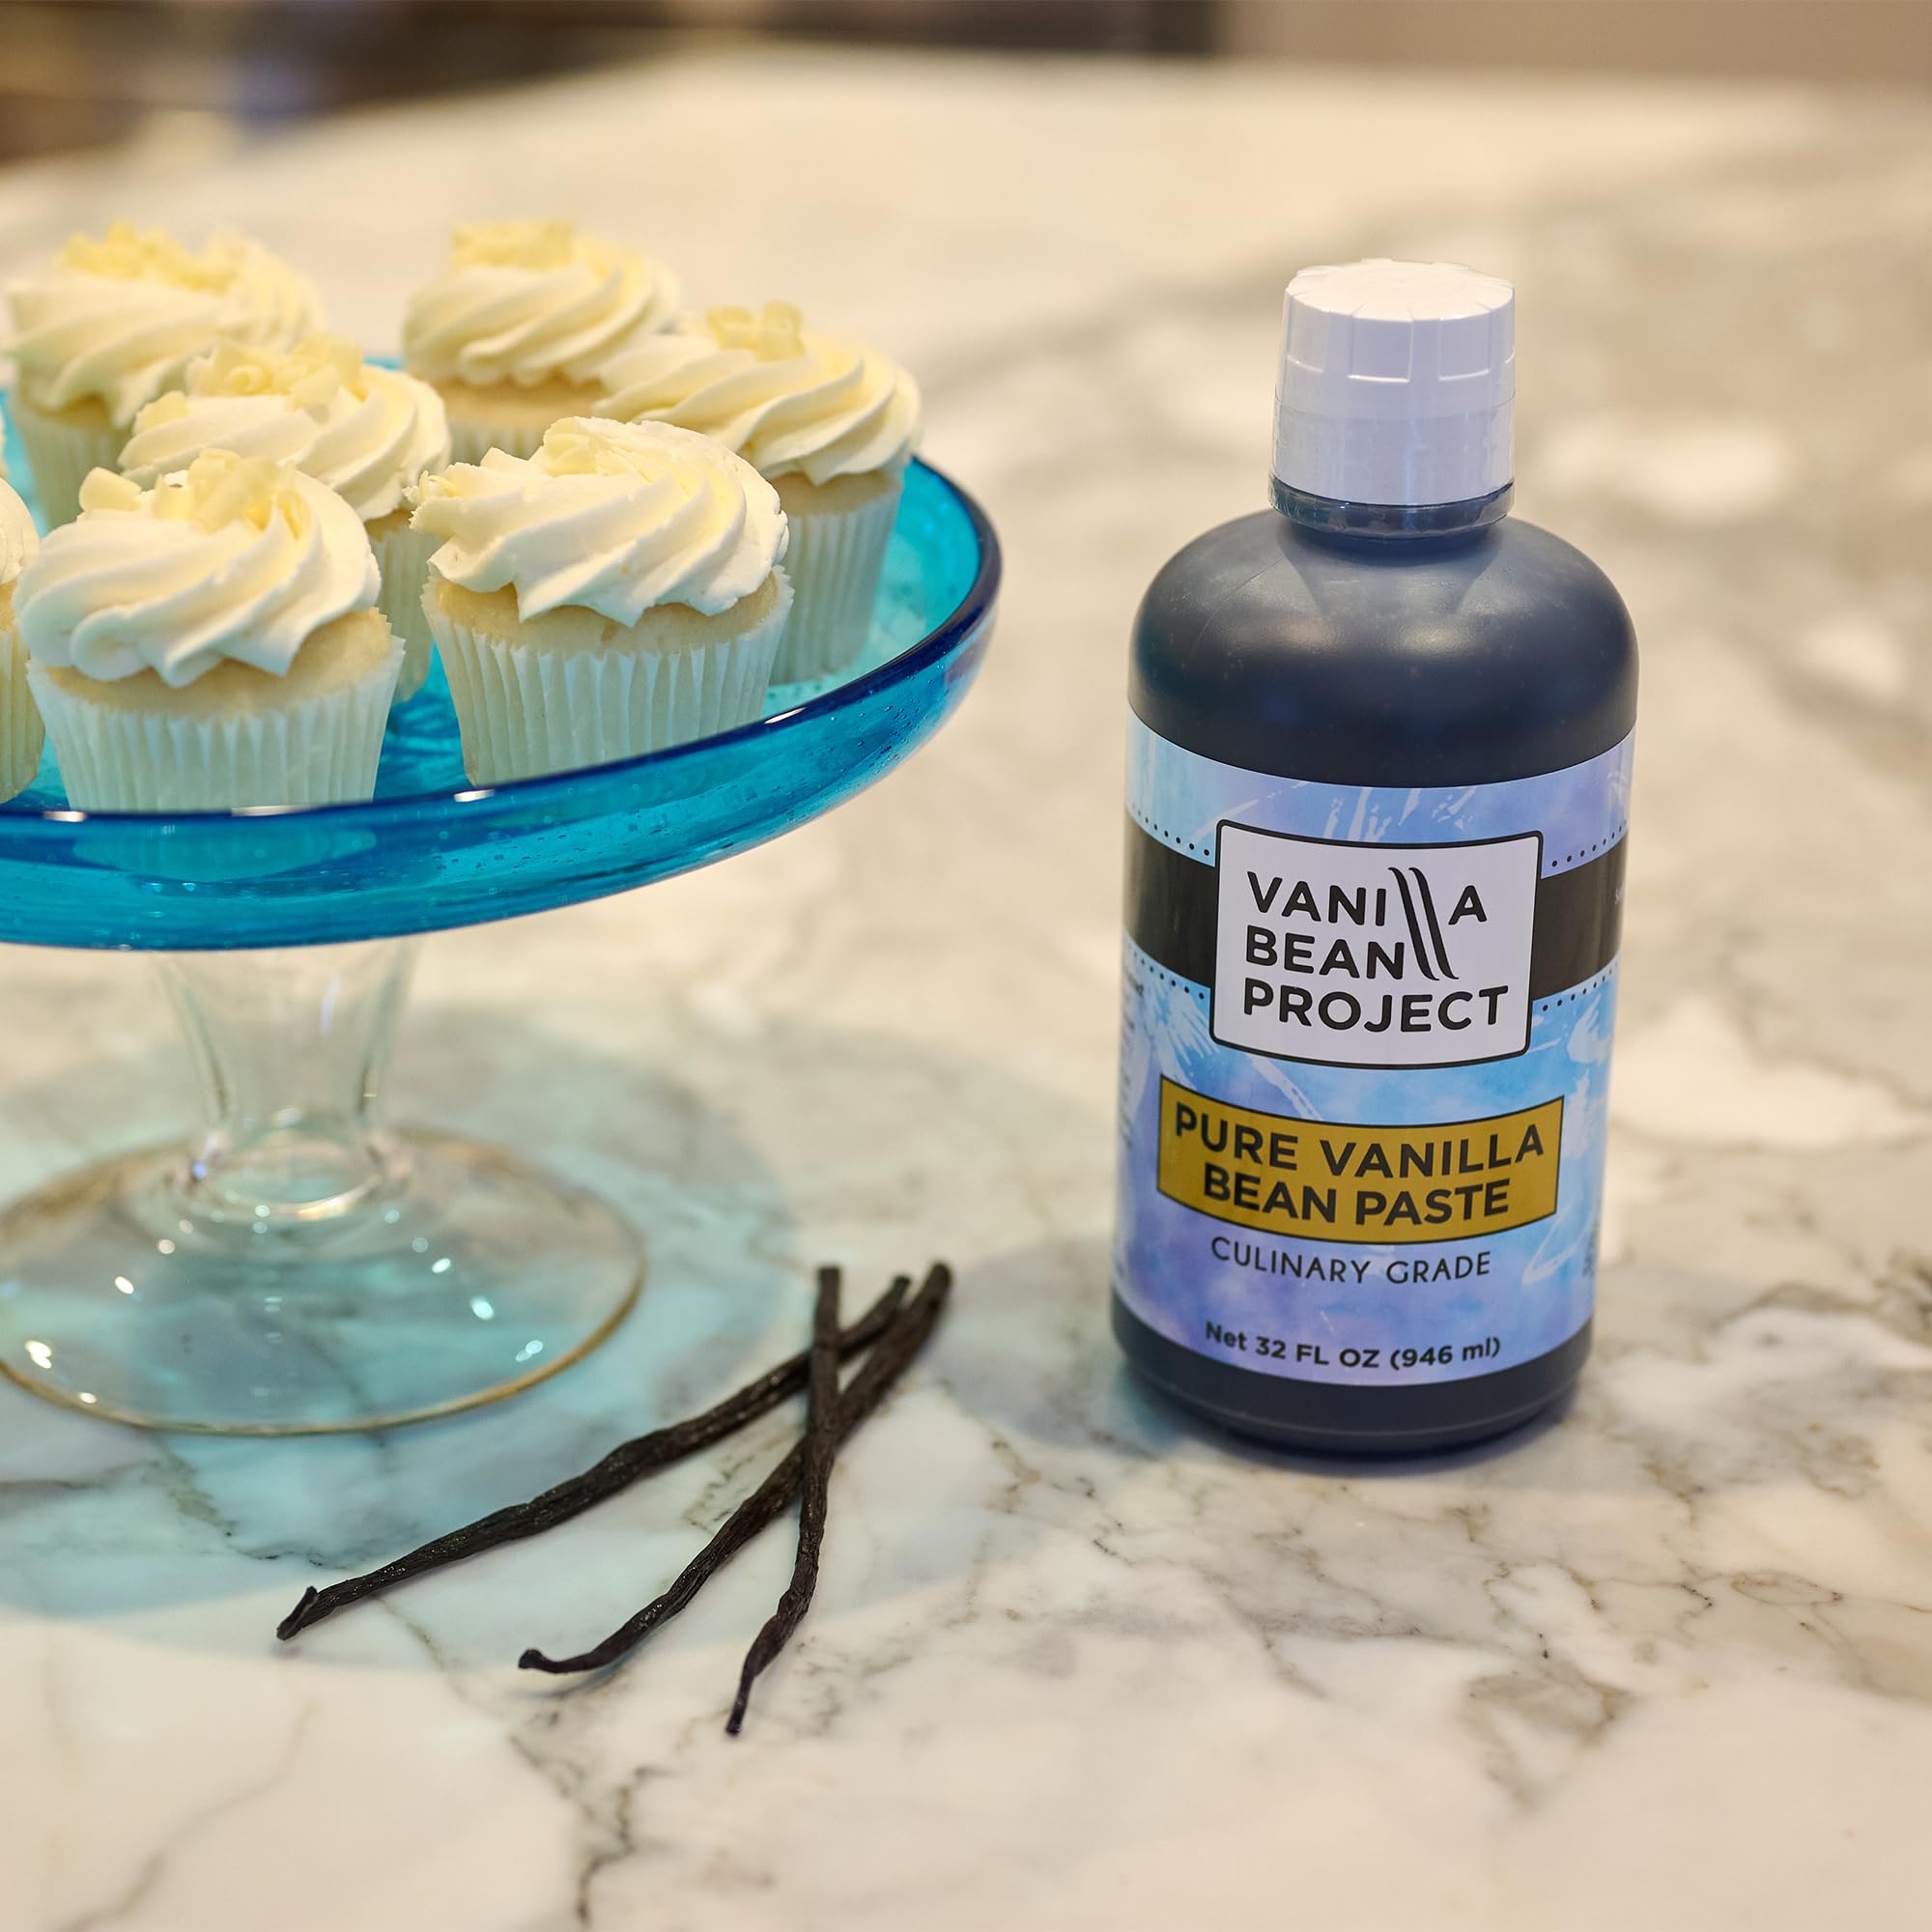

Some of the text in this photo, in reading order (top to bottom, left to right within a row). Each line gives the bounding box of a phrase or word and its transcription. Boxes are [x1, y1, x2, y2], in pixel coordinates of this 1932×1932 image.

[1245, 924, 1406, 980] BEAN
[1243, 978, 1509, 1033] PROJECT
[1175, 1101, 1545, 1179] PURE VANILLA
[1204, 1164, 1511, 1227] BEAN PASTE
[1210, 1236, 1492, 1285] CULINARY GRADE
[1205, 1320, 1501, 1370] Net 32 FL OZ (946 ml)
